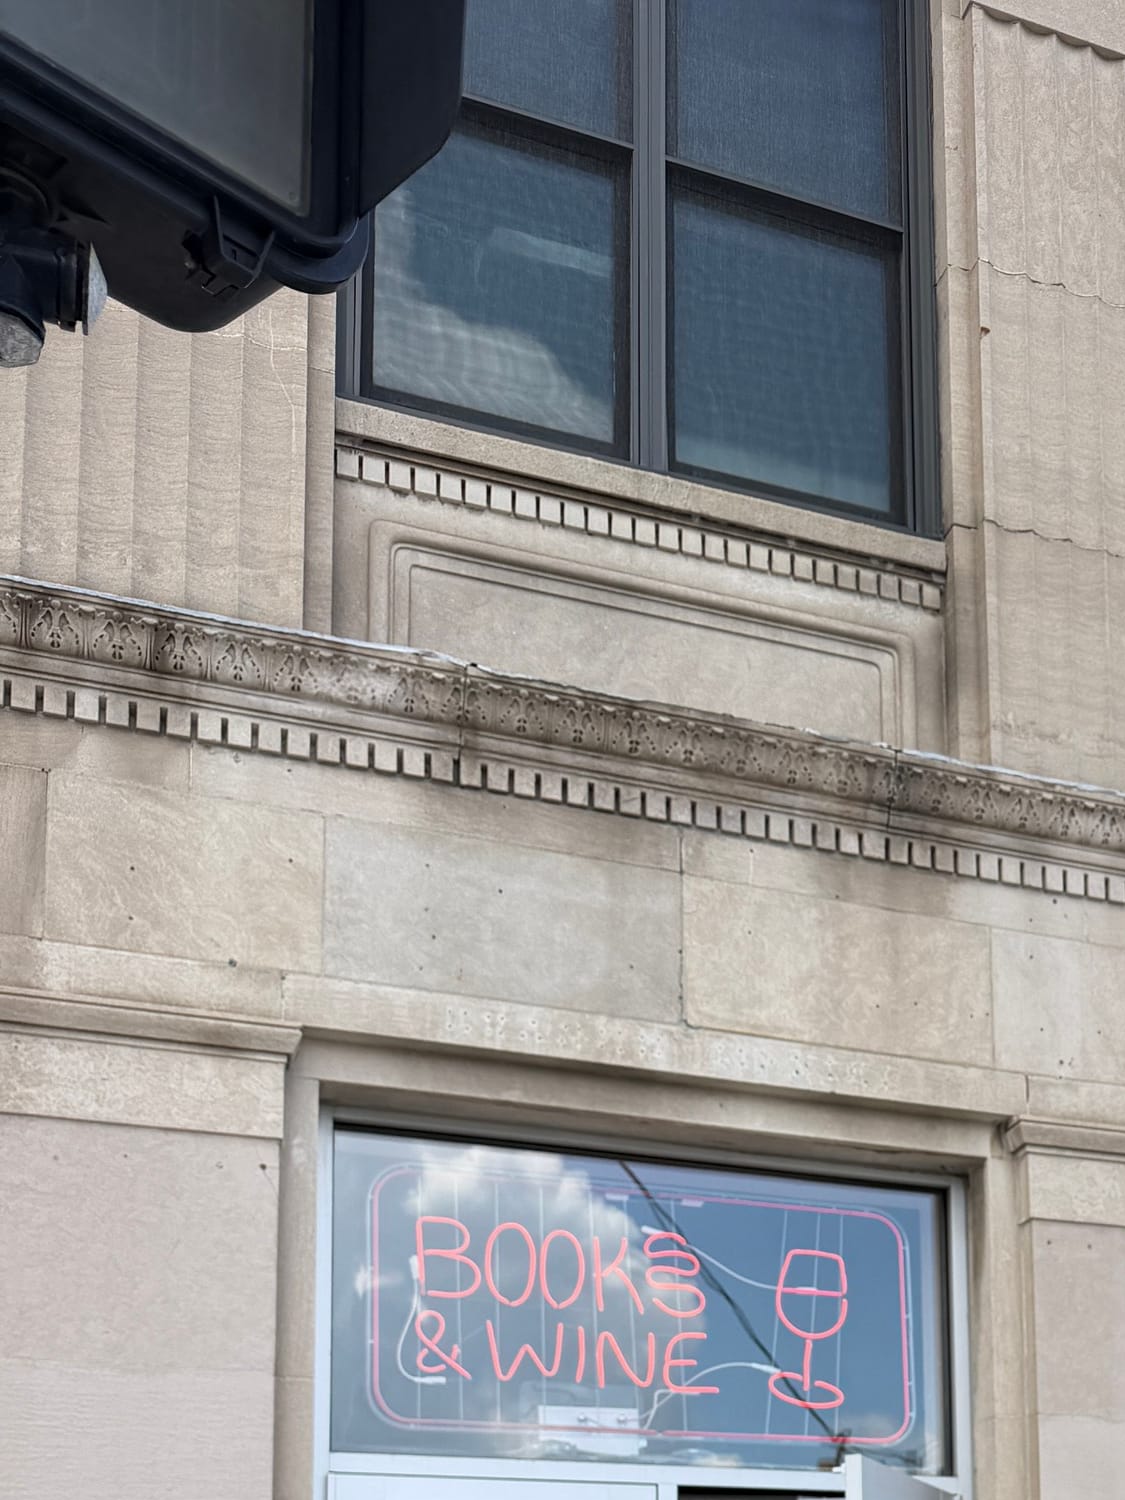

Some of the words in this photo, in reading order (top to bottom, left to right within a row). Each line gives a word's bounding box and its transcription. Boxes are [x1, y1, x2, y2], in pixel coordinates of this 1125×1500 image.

[415, 1215, 706, 1319] BOOKS
[415, 1309, 473, 1381] &
[486, 1319, 720, 1395] WINE
